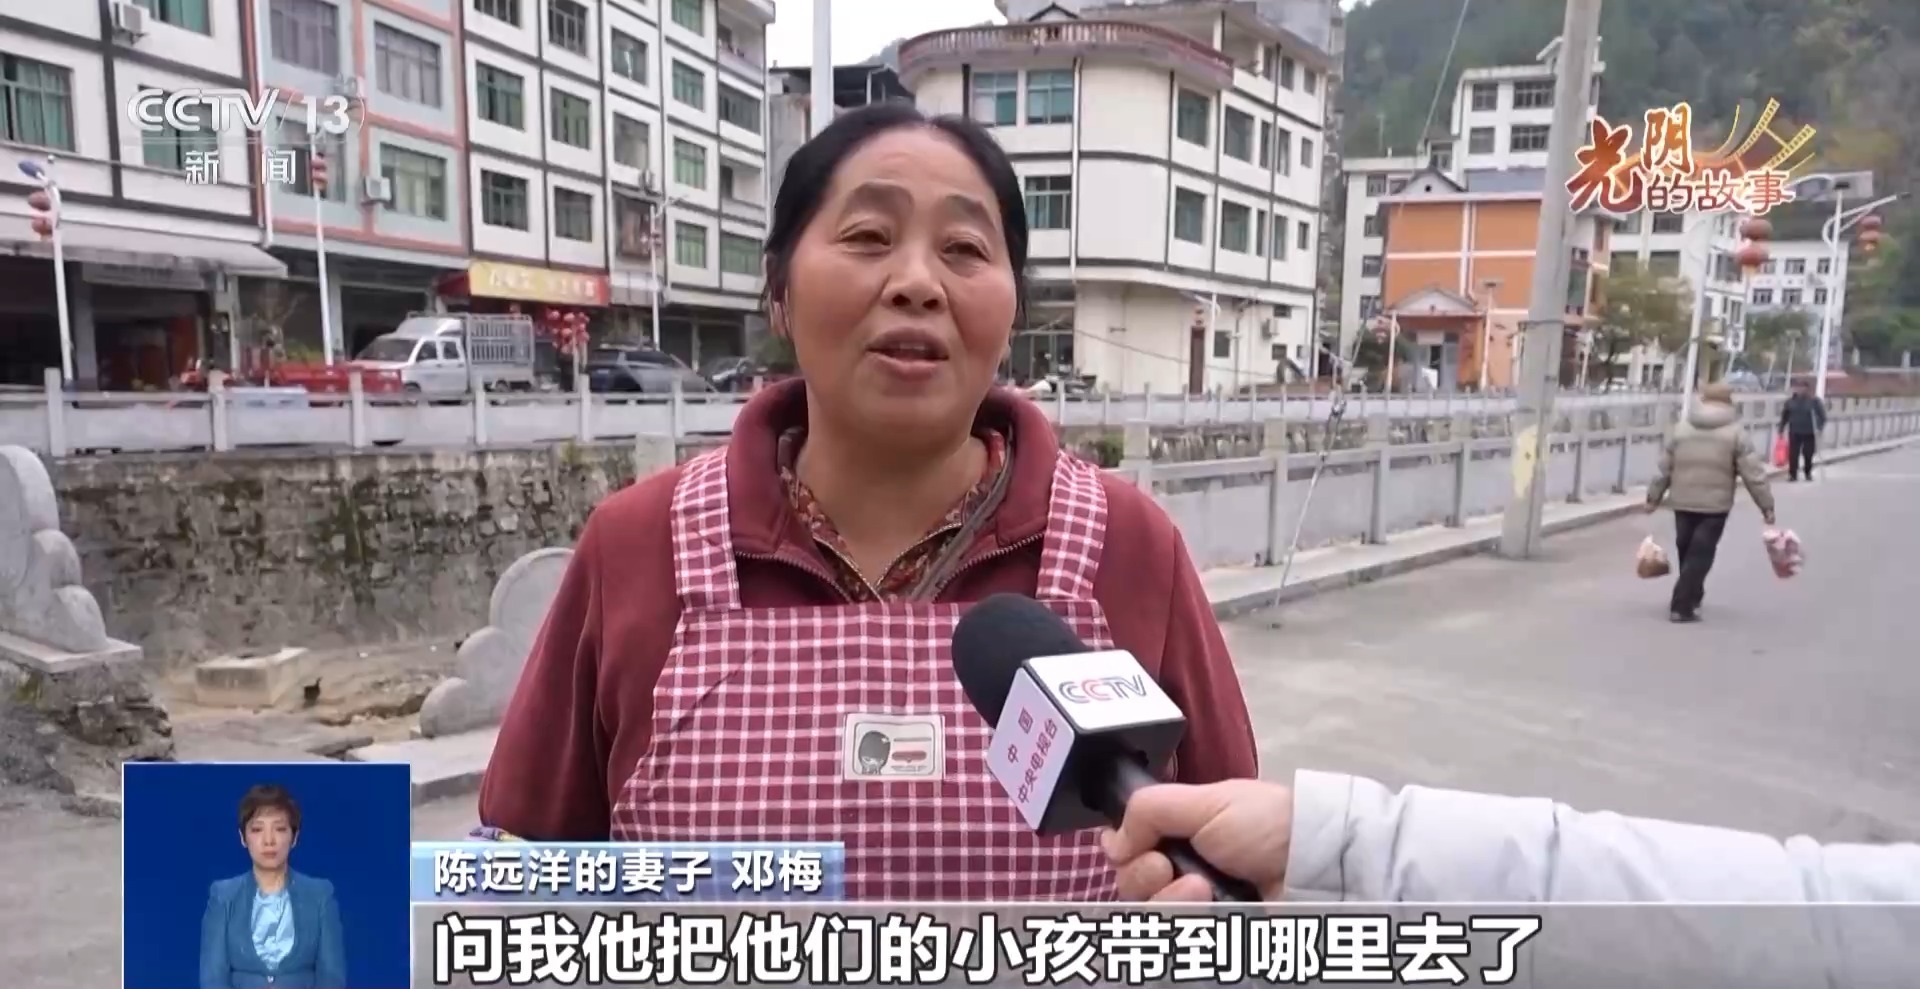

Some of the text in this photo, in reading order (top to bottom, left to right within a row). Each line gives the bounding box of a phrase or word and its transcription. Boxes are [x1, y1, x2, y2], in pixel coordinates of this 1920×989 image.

[1058, 674, 1147, 704] CCTV
[1018, 717, 1059, 804] 中央电视台
